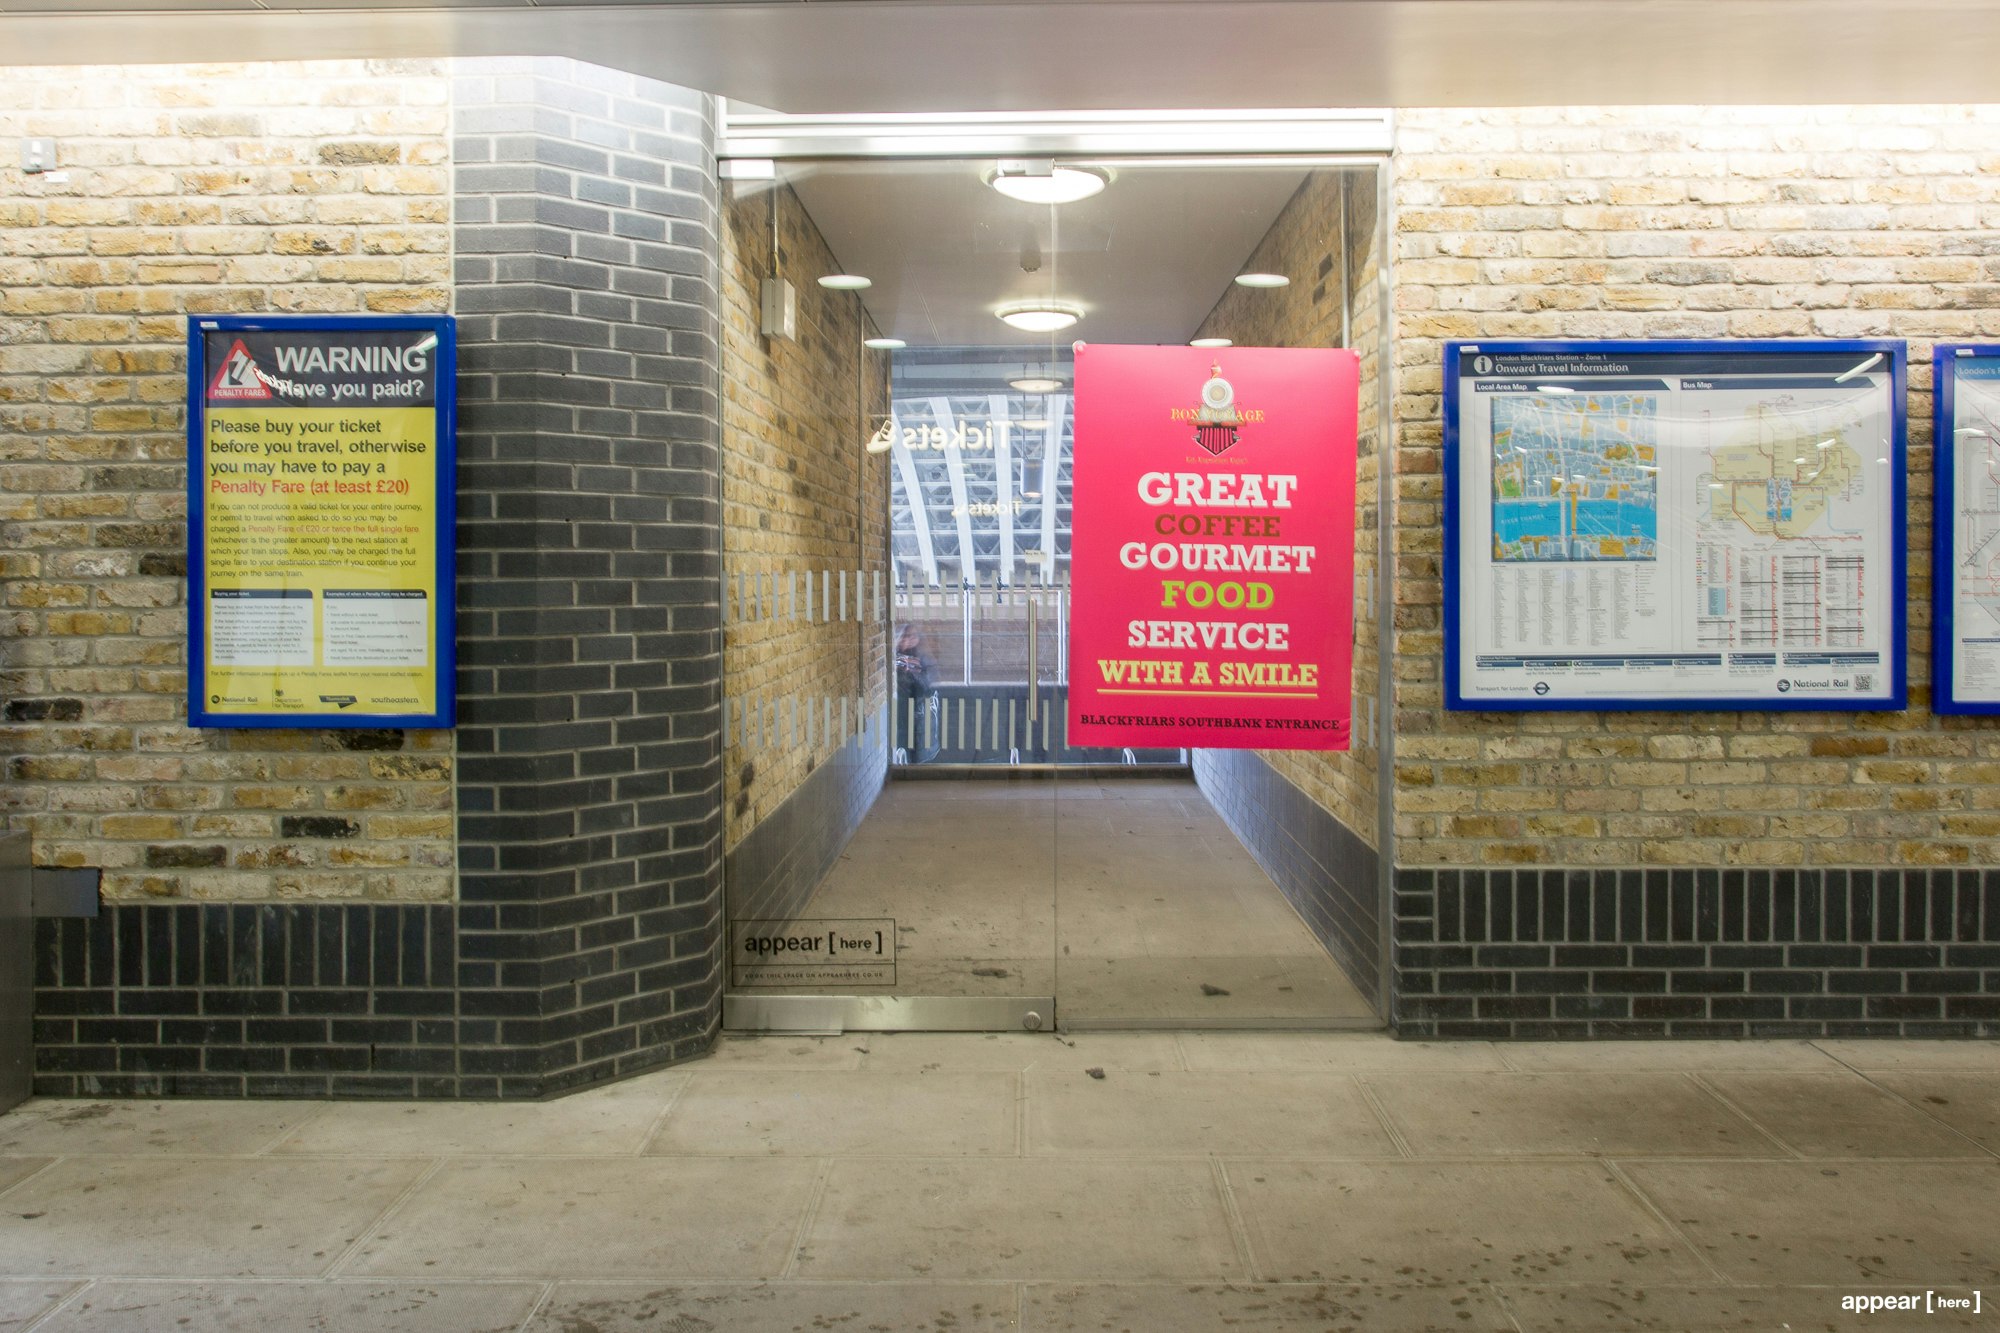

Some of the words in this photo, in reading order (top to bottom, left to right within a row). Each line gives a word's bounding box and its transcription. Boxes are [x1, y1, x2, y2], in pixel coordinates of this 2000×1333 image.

[275, 347, 427, 373] WARNING
[1495, 364, 1535, 373] Onward
[1538, 364, 1568, 372] Travel
[1570, 363, 1628, 372] Information
[332, 384, 366, 400] you
[372, 380, 424, 400] paid?
[1696, 382, 1712, 390] Map
[1170, 408, 1200, 420] BON
[211, 419, 260, 432] Please
[266, 419, 293, 436] buy
[300, 422, 334, 436] your
[340, 419, 381, 432] ticket
[211, 440, 259, 452] before
[264, 442, 291, 456] you
[297, 440, 342, 454] travel,
[349, 440, 426, 452] otherwise
[210, 462, 237, 476] you
[244, 462, 275, 476] may
[282, 460, 316, 472] have
[322, 460, 336, 472] to
[343, 462, 370, 476] pay
[377, 462, 385, 472] a
[211, 480, 266, 496] Penalty
[272, 480, 304, 493] Fare
[311, 478, 328, 495] (at
[335, 480, 371, 493] least
[376, 478, 409, 495] £20)
[1138, 472, 1296, 508] GREAT
[262, 503, 290, 511] produce
[394, 503, 422, 511] journey,
[220, 514, 242, 522] permit
[1155, 514, 1280, 536] COFFEE
[210, 525, 239, 534] charged
[249, 525, 274, 534] Penalty
[381, 525, 401, 534] single
[211, 536, 248, 545] (whichever
[273, 536, 297, 545] greater
[300, 536, 329, 545] amount)
[269, 547, 289, 556] stops.
[293, 547, 310, 556] Also,
[359, 547, 388, 556] charged
[1120, 542, 1316, 572] GOURMET
[211, 558, 230, 567] single
[210, 569, 236, 578] journey
[1161, 580, 1274, 609] FOOD
[1128, 620, 1288, 650] SERVICE
[1098, 660, 1183, 684] WITH
[1190, 662, 1212, 684] A
[1219, 663, 1318, 686] SMILE
[1794, 679, 1829, 687] National
[1833, 679, 1848, 687] Rail
[1081, 715, 1175, 726] BLACKFRIARS
[1178, 717, 1262, 728] SOUTHBANK
[1266, 719, 1340, 730] ENTRANCE
[744, 936, 822, 955] appear
